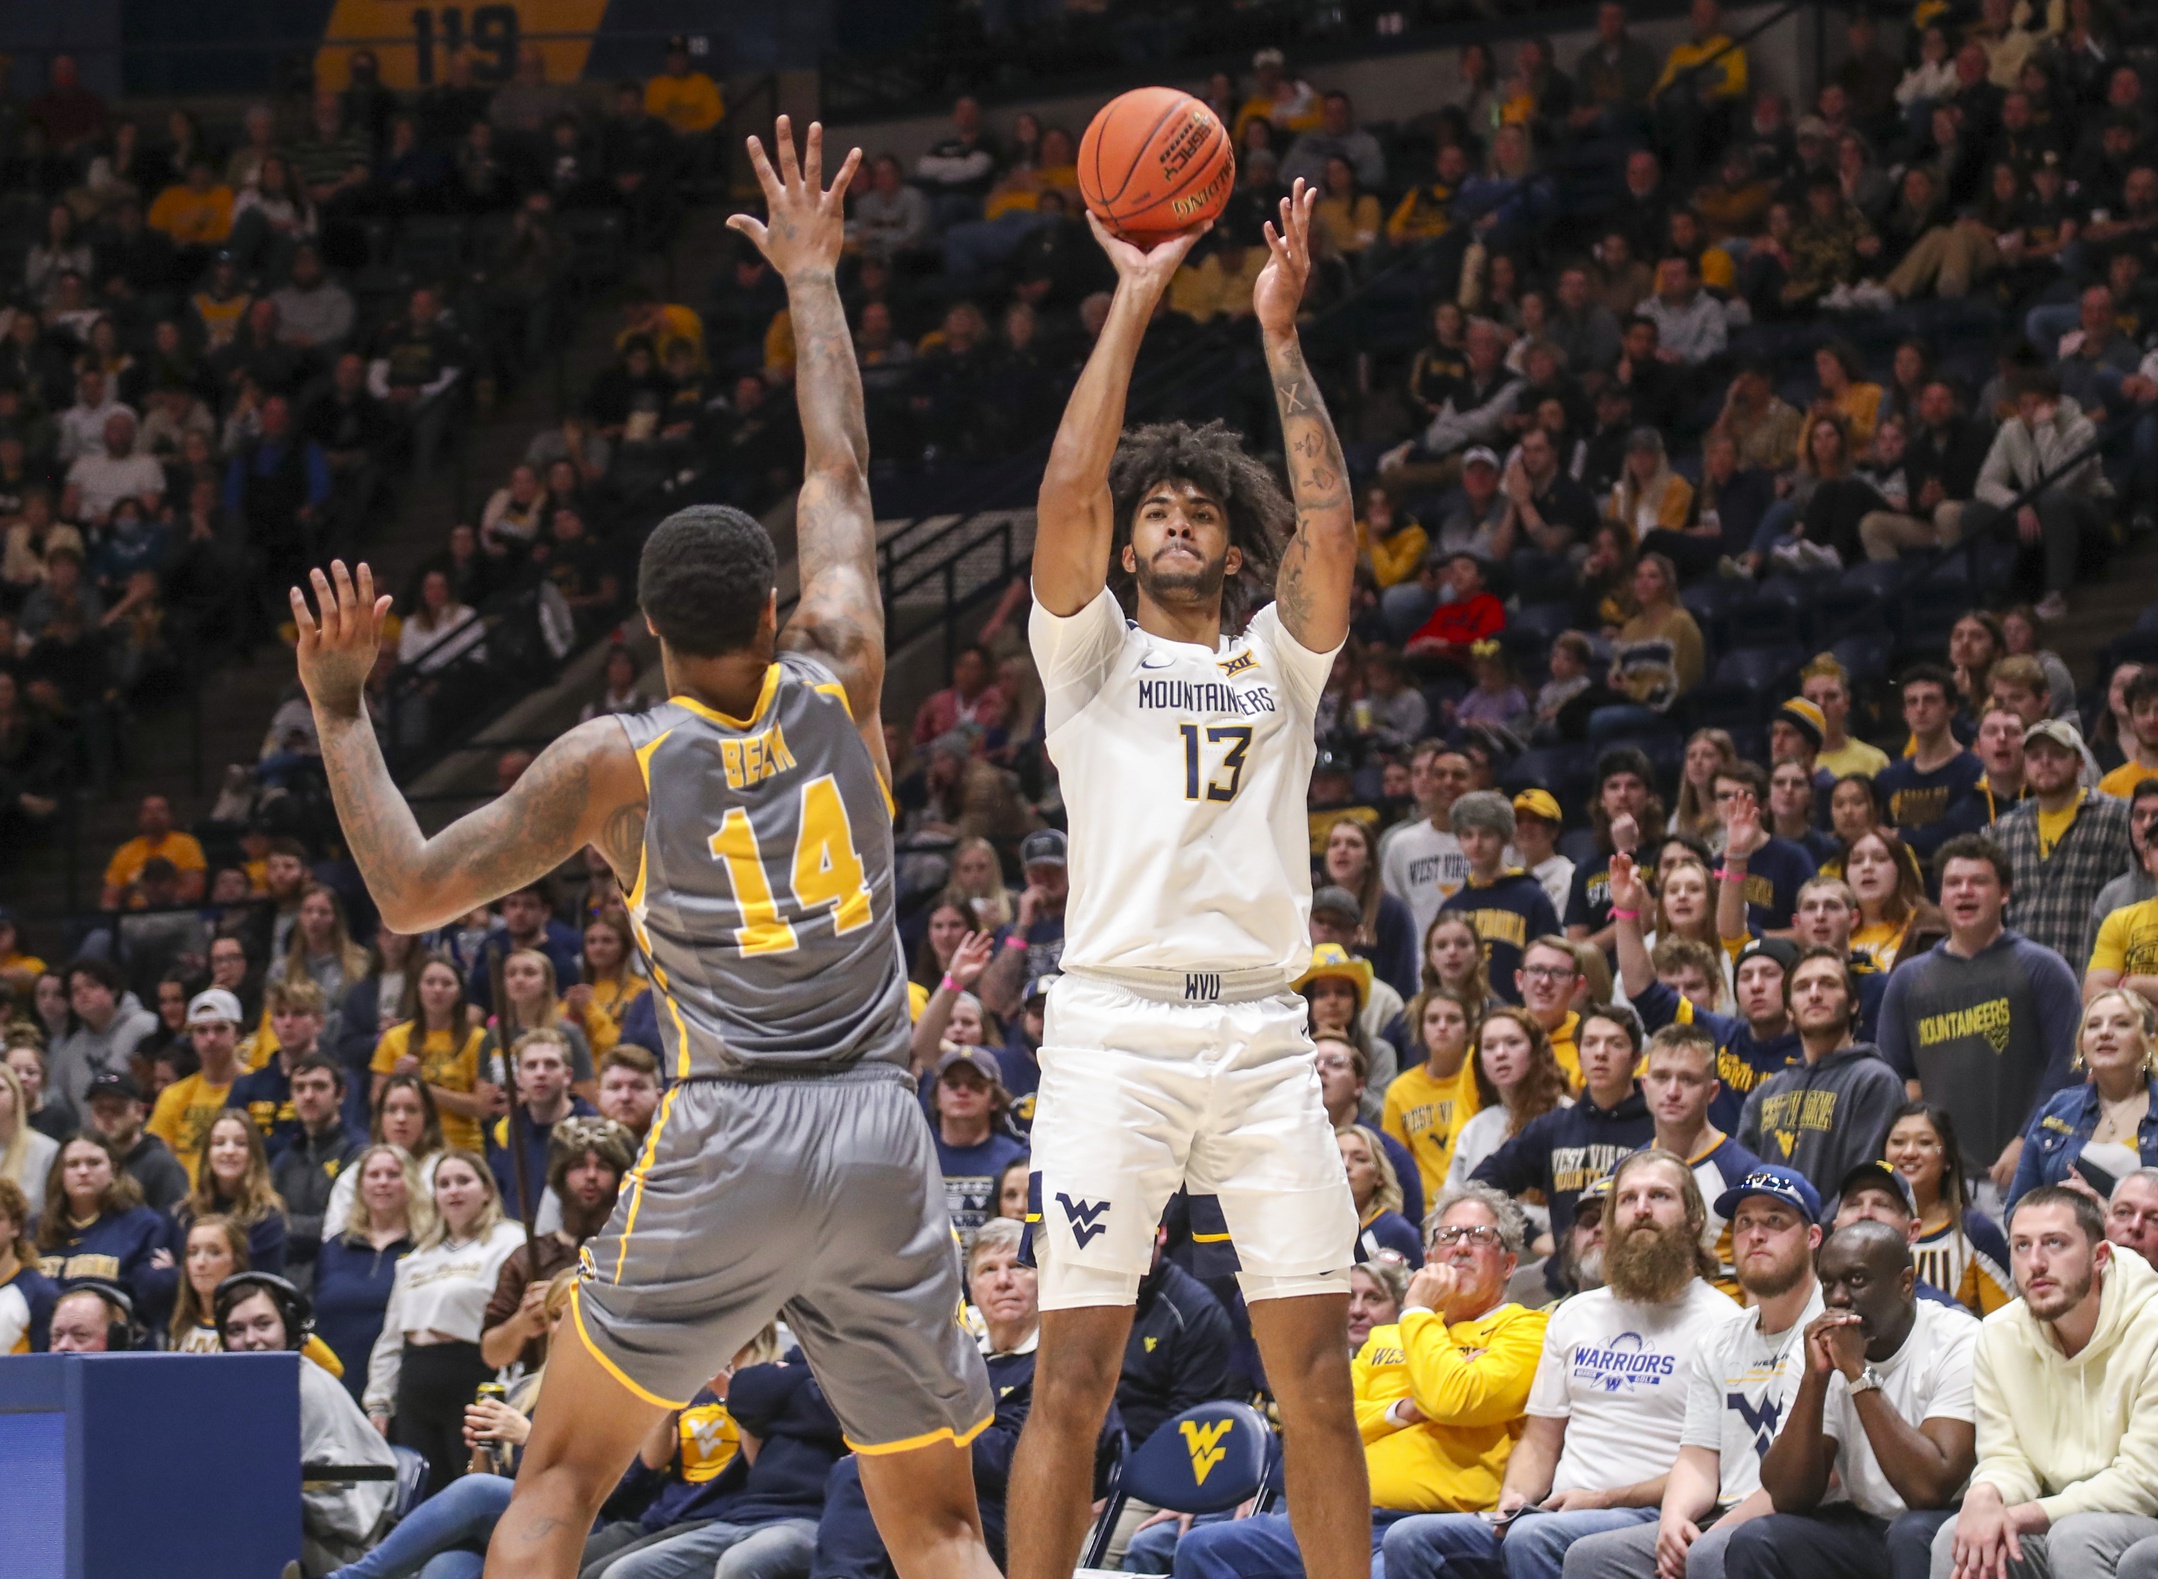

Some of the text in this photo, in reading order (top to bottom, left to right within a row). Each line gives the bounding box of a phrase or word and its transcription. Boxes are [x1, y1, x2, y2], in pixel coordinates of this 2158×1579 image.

[412, 5, 517, 82] 119
[1138, 679, 1276, 716] MOUNTAINERS
[1178, 721, 1254, 803] 13
[707, 772, 873, 958] 14
[1184, 973, 1221, 1000] WVU
[1575, 1346, 1675, 1375] WARRIORS
